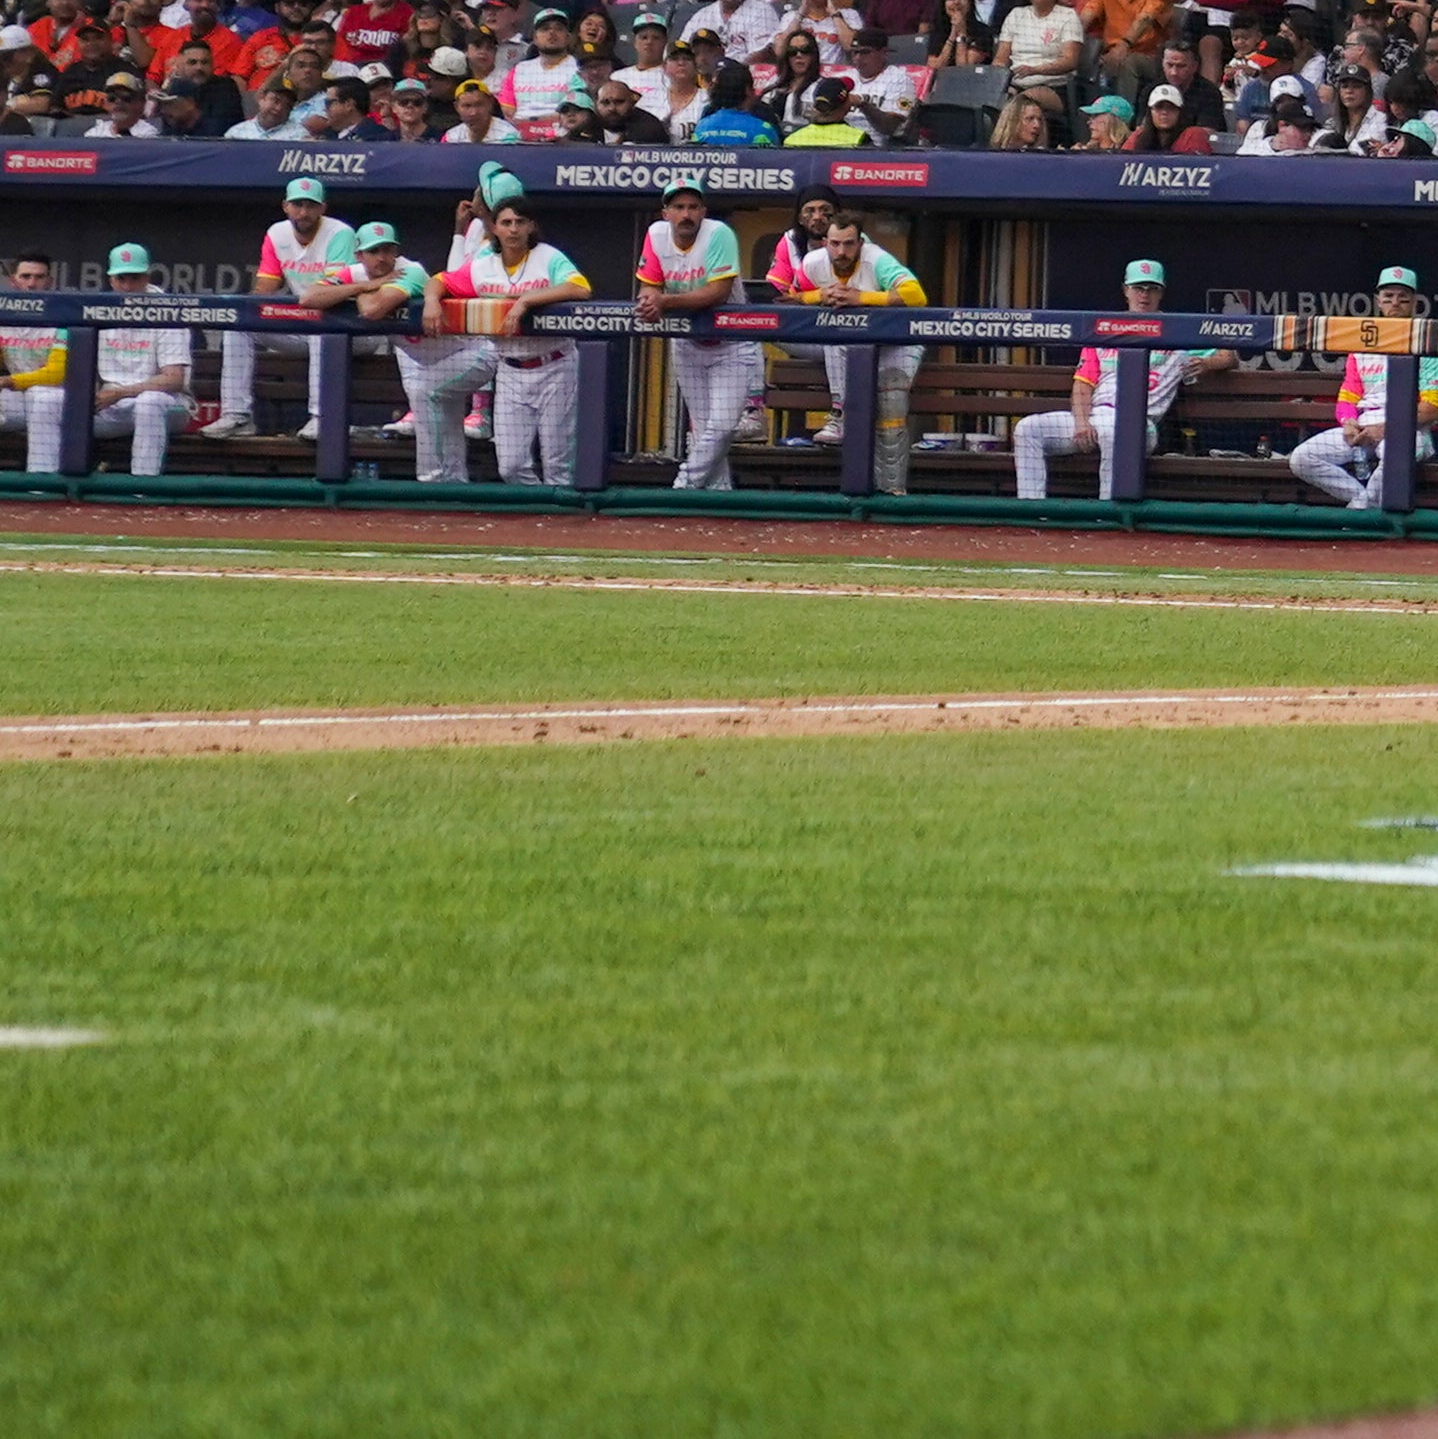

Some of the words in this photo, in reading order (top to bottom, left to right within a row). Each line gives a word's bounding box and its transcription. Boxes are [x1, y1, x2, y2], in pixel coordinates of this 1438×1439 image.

[26, 157, 93, 169] BANORTE
[634, 151, 660, 163] MLB
[661, 151, 703, 164] WORLD
[704, 153, 737, 164] TOUR
[556, 165, 651, 188] MEXICO
[707, 167, 794, 190] SERIES
[855, 169, 924, 181] BANORTE
[148, 263, 241, 295] ORLD
[1256, 291, 1318, 315] MLB
[1320, 292, 1432, 318] WOD
[83, 305, 147, 321] MEXICO
[148, 307, 181, 322] CITY
[182, 307, 237, 323] SERIES
[533, 315, 595, 330] MEXICO
[596, 317, 634, 332] CITY
[635, 317, 692, 333] SERIES
[910, 320, 973, 336] MEXICO
[974, 322, 1011, 337] CITY
[1012, 322, 1071, 339] SERIES
